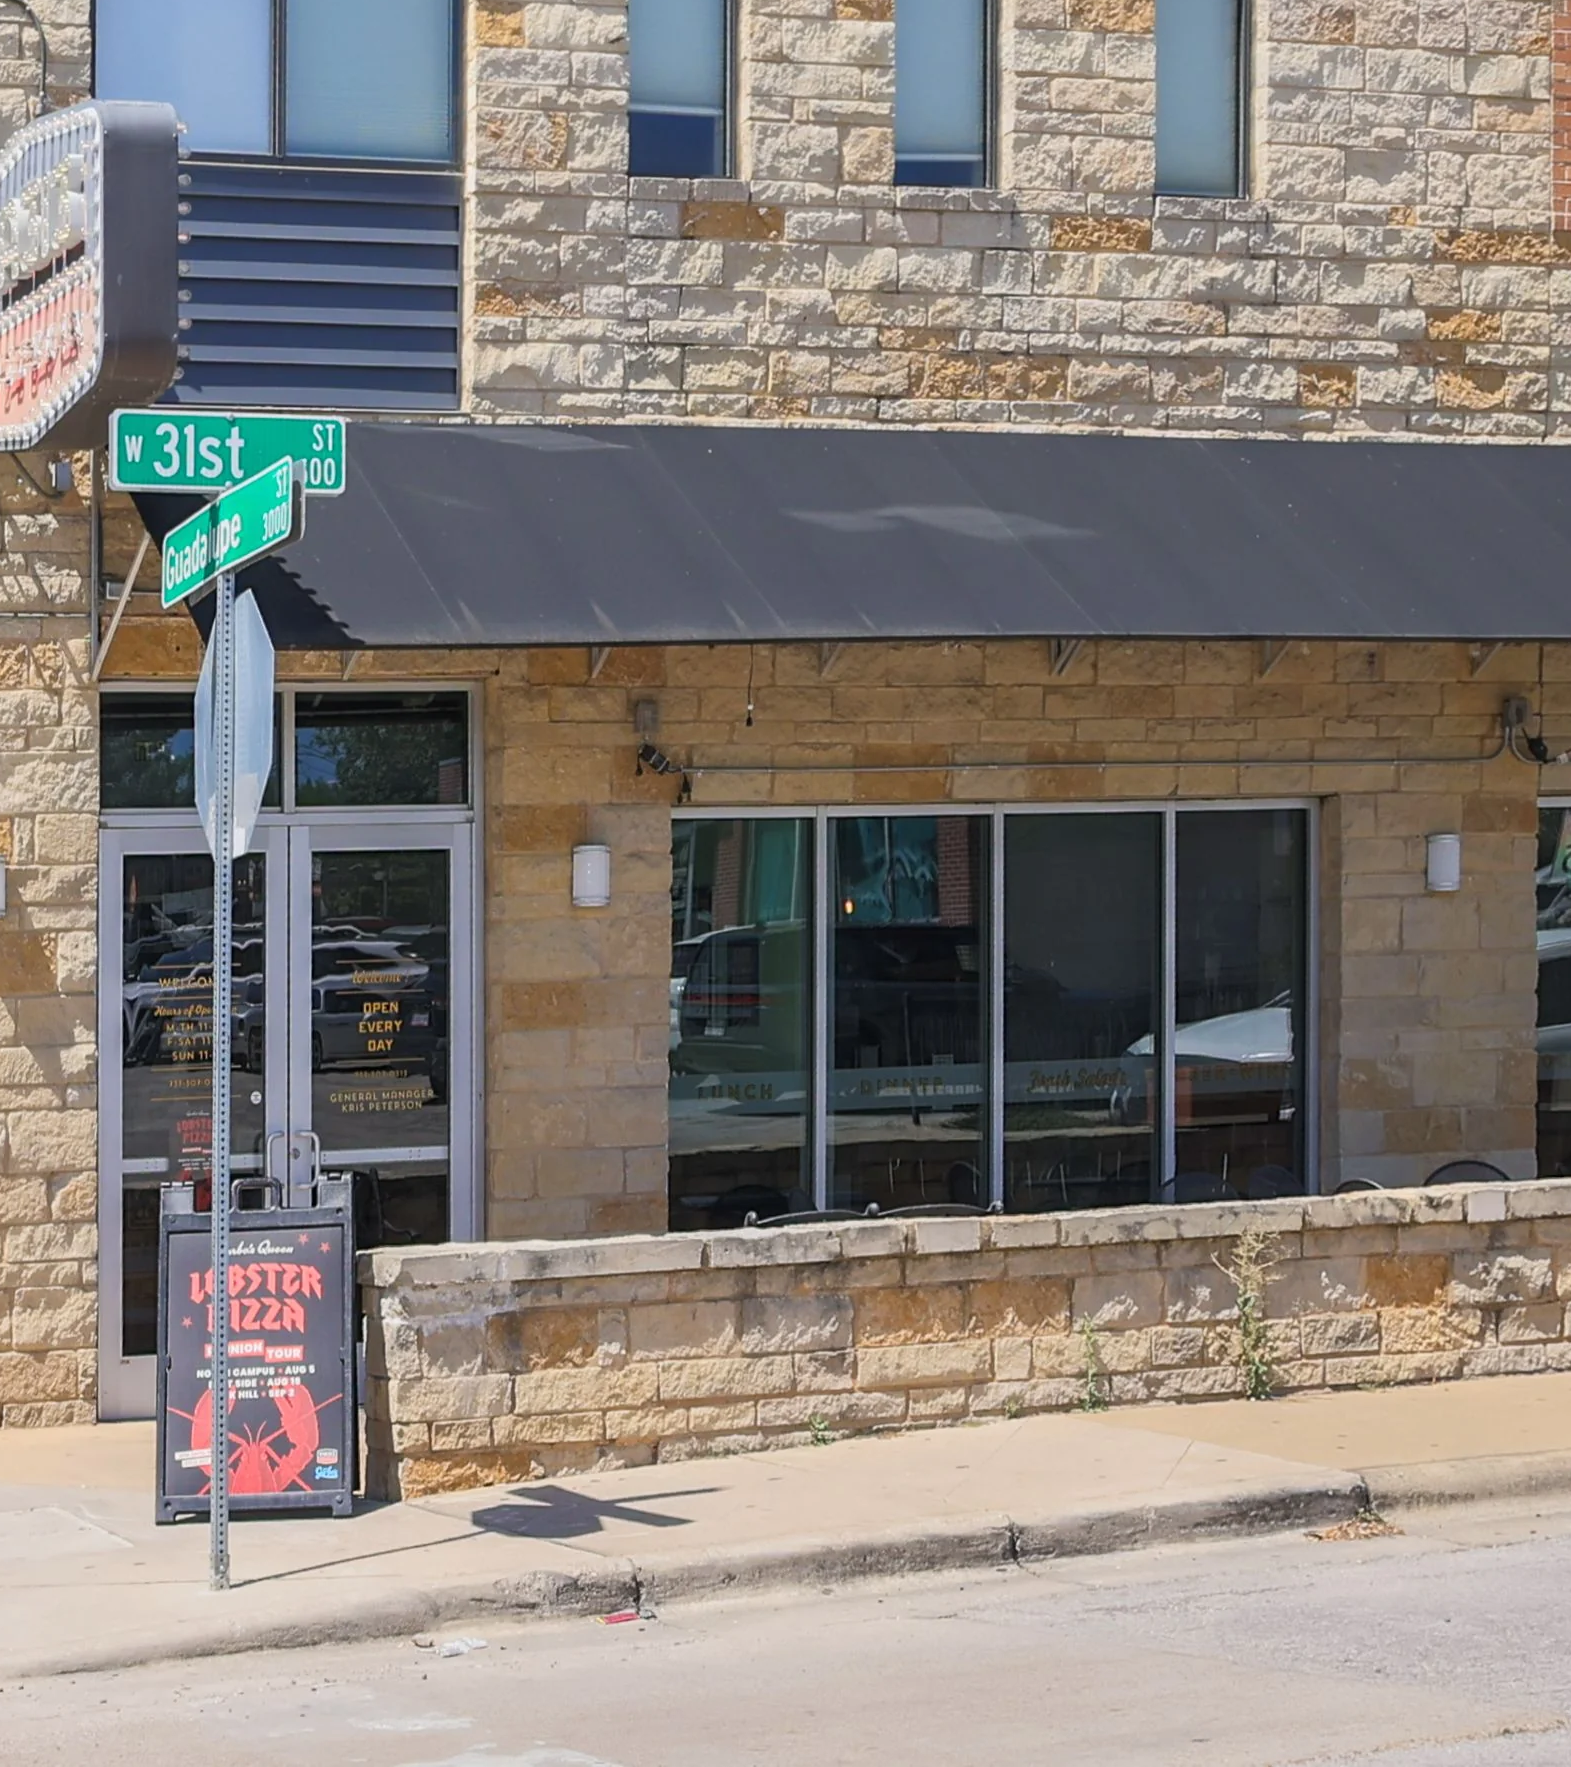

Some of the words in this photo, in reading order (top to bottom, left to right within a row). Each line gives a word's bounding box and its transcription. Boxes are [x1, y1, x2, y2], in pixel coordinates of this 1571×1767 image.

[124, 435, 143, 463] W
[153, 422, 245, 479] 31st
[312, 423, 336, 452] ST
[304, 457, 336, 486] 00
[273, 464, 290, 499] ST
[159, 977, 214, 989] WELCO
[363, 1001, 400, 1014] OPEN
[358, 1019, 403, 1033] EVERY
[367, 1039, 395, 1052] DAY
[172, 1051, 195, 1062] SUN
[330, 1092, 379, 1104] GENERAL
[381, 1089, 435, 1101] MANAGER
[697, 1082, 774, 1101] LUNCH
[341, 1102, 365, 1113] KRIS
[368, 1100, 423, 1112] PETERSON
[267, 1347, 302, 1360] TOUR
[232, 1366, 276, 1378] CAMPUS
[284, 1364, 306, 1374] AUG
[235, 1377, 258, 1388] SIDE
[267, 1376, 289, 1387] AUG
[238, 1389, 260, 1400] HILL
[268, 1389, 288, 1399] SEP
